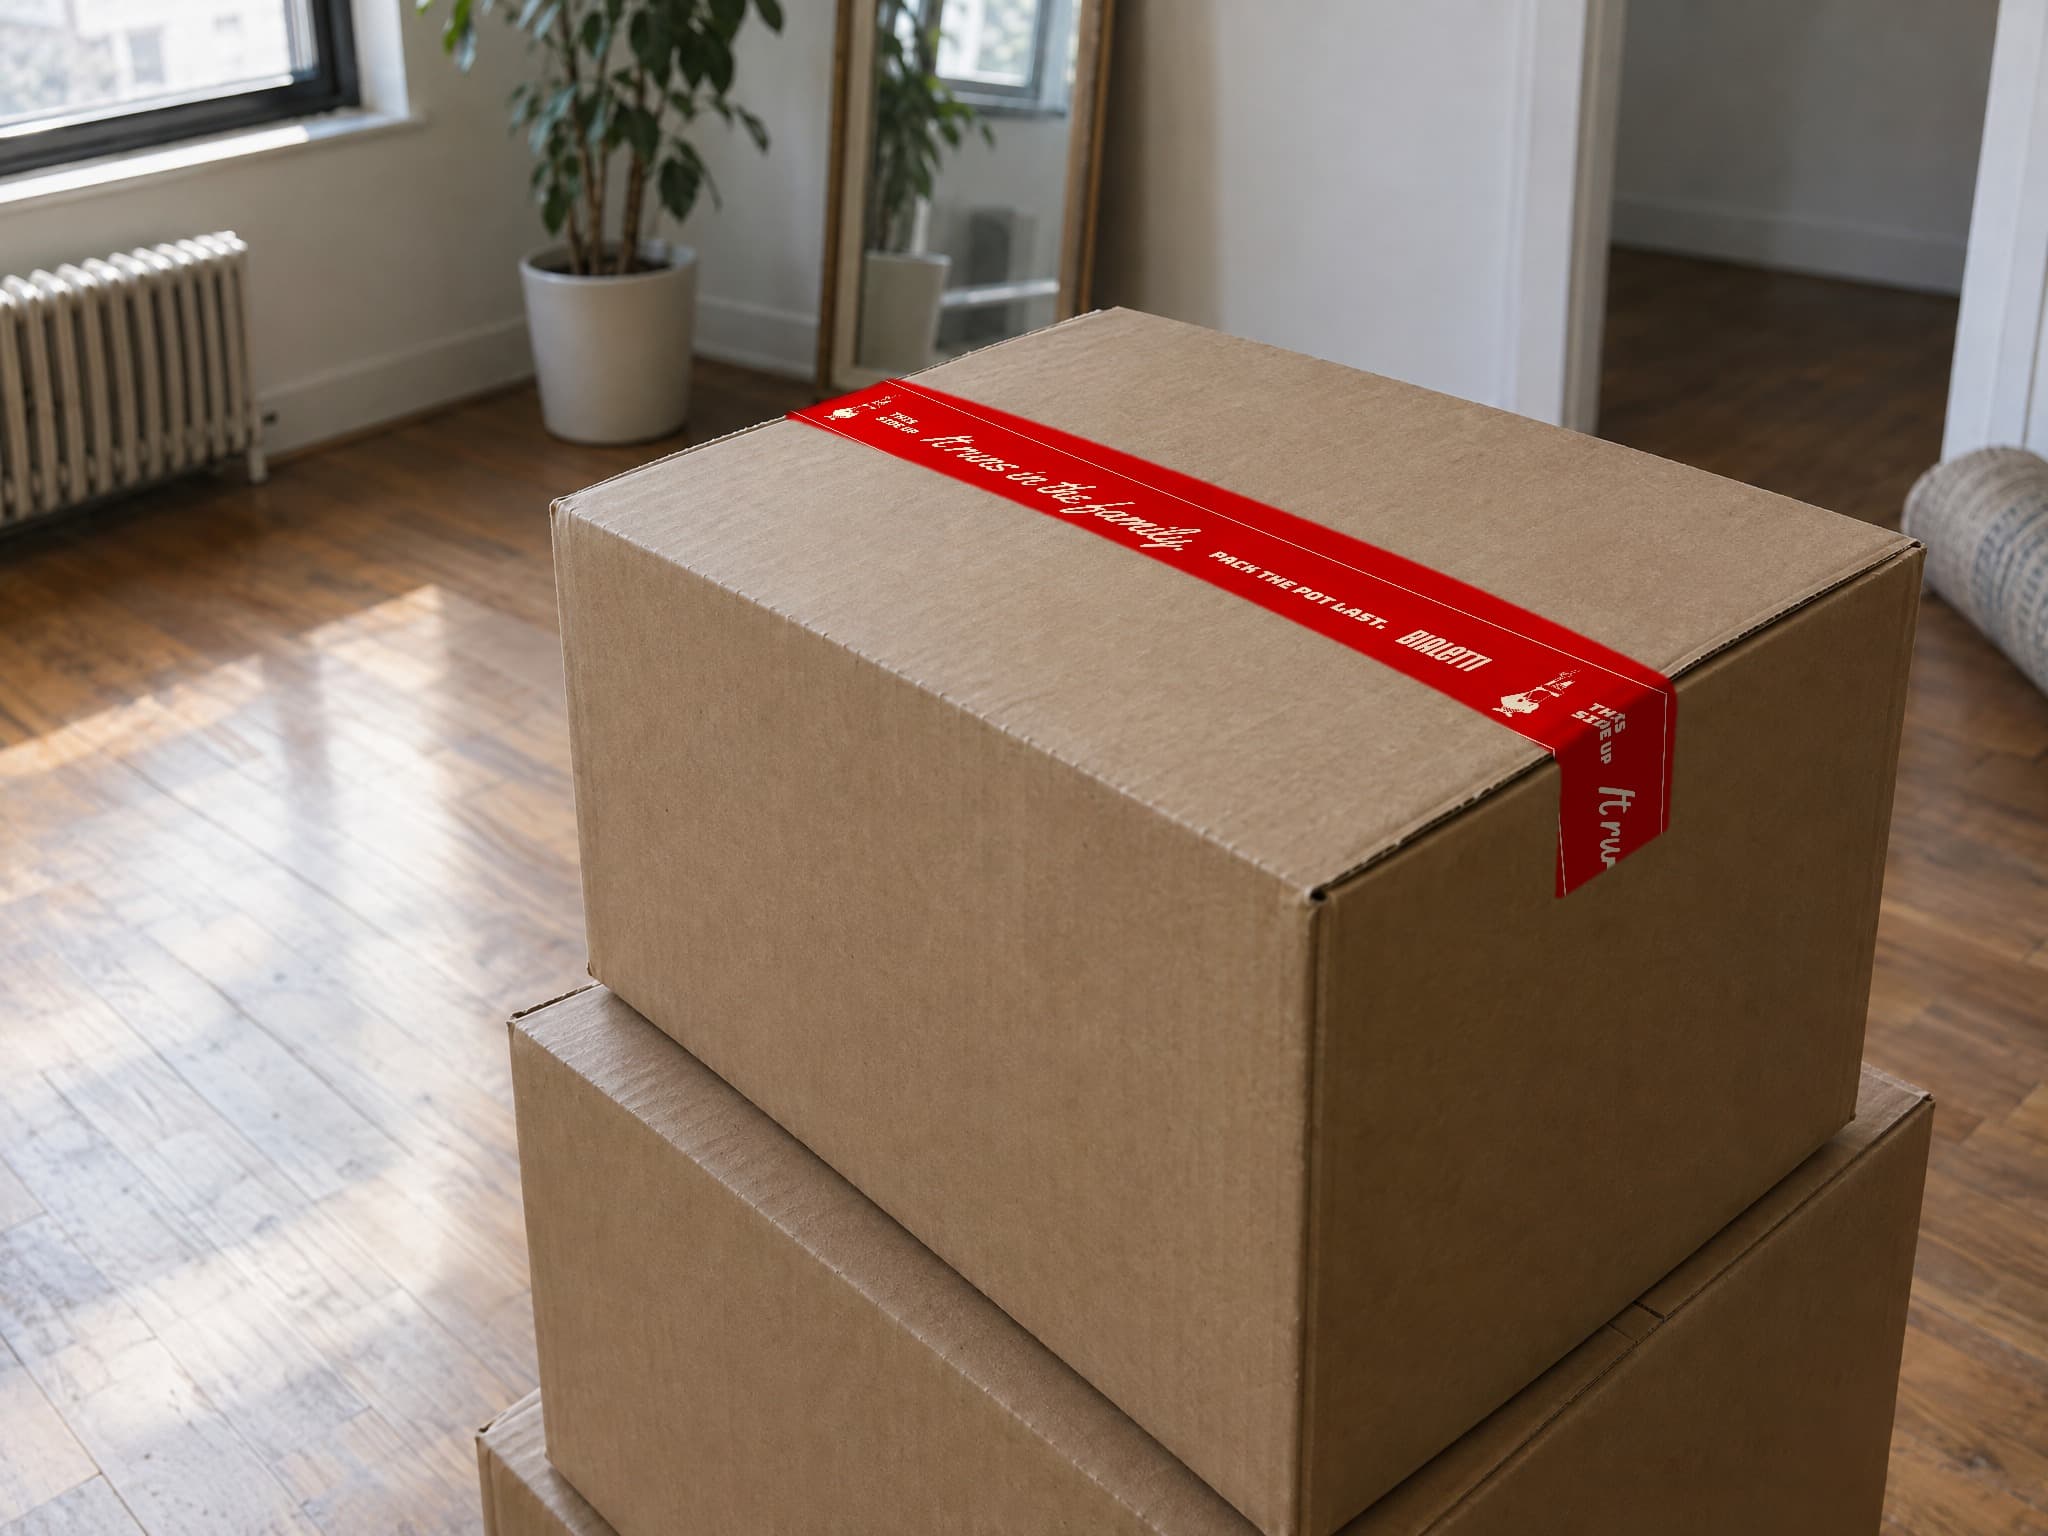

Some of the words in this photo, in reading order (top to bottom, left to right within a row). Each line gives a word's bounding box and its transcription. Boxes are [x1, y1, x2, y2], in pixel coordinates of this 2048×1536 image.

[875, 416, 905, 428] SIDE
[900, 426, 919, 434] UP
[919, 435, 975, 447] It
[944, 446, 1020, 471] runs
[1005, 471, 1048, 486] in
[1036, 481, 1096, 504] the
[1059, 501, 1201, 551] family.
[1208, 551, 1260, 574] PACK
[1257, 570, 1298, 590] THE
[1292, 586, 1337, 606] POT
[1330, 602, 1389, 630] LAST.
[1394, 629, 1493, 672] BIALETTI
[1589, 702, 1626, 734] THIS
[1570, 710, 1612, 741] SIDE
[1600, 740, 1612, 764] UP
[1598, 786, 1636, 816] It
